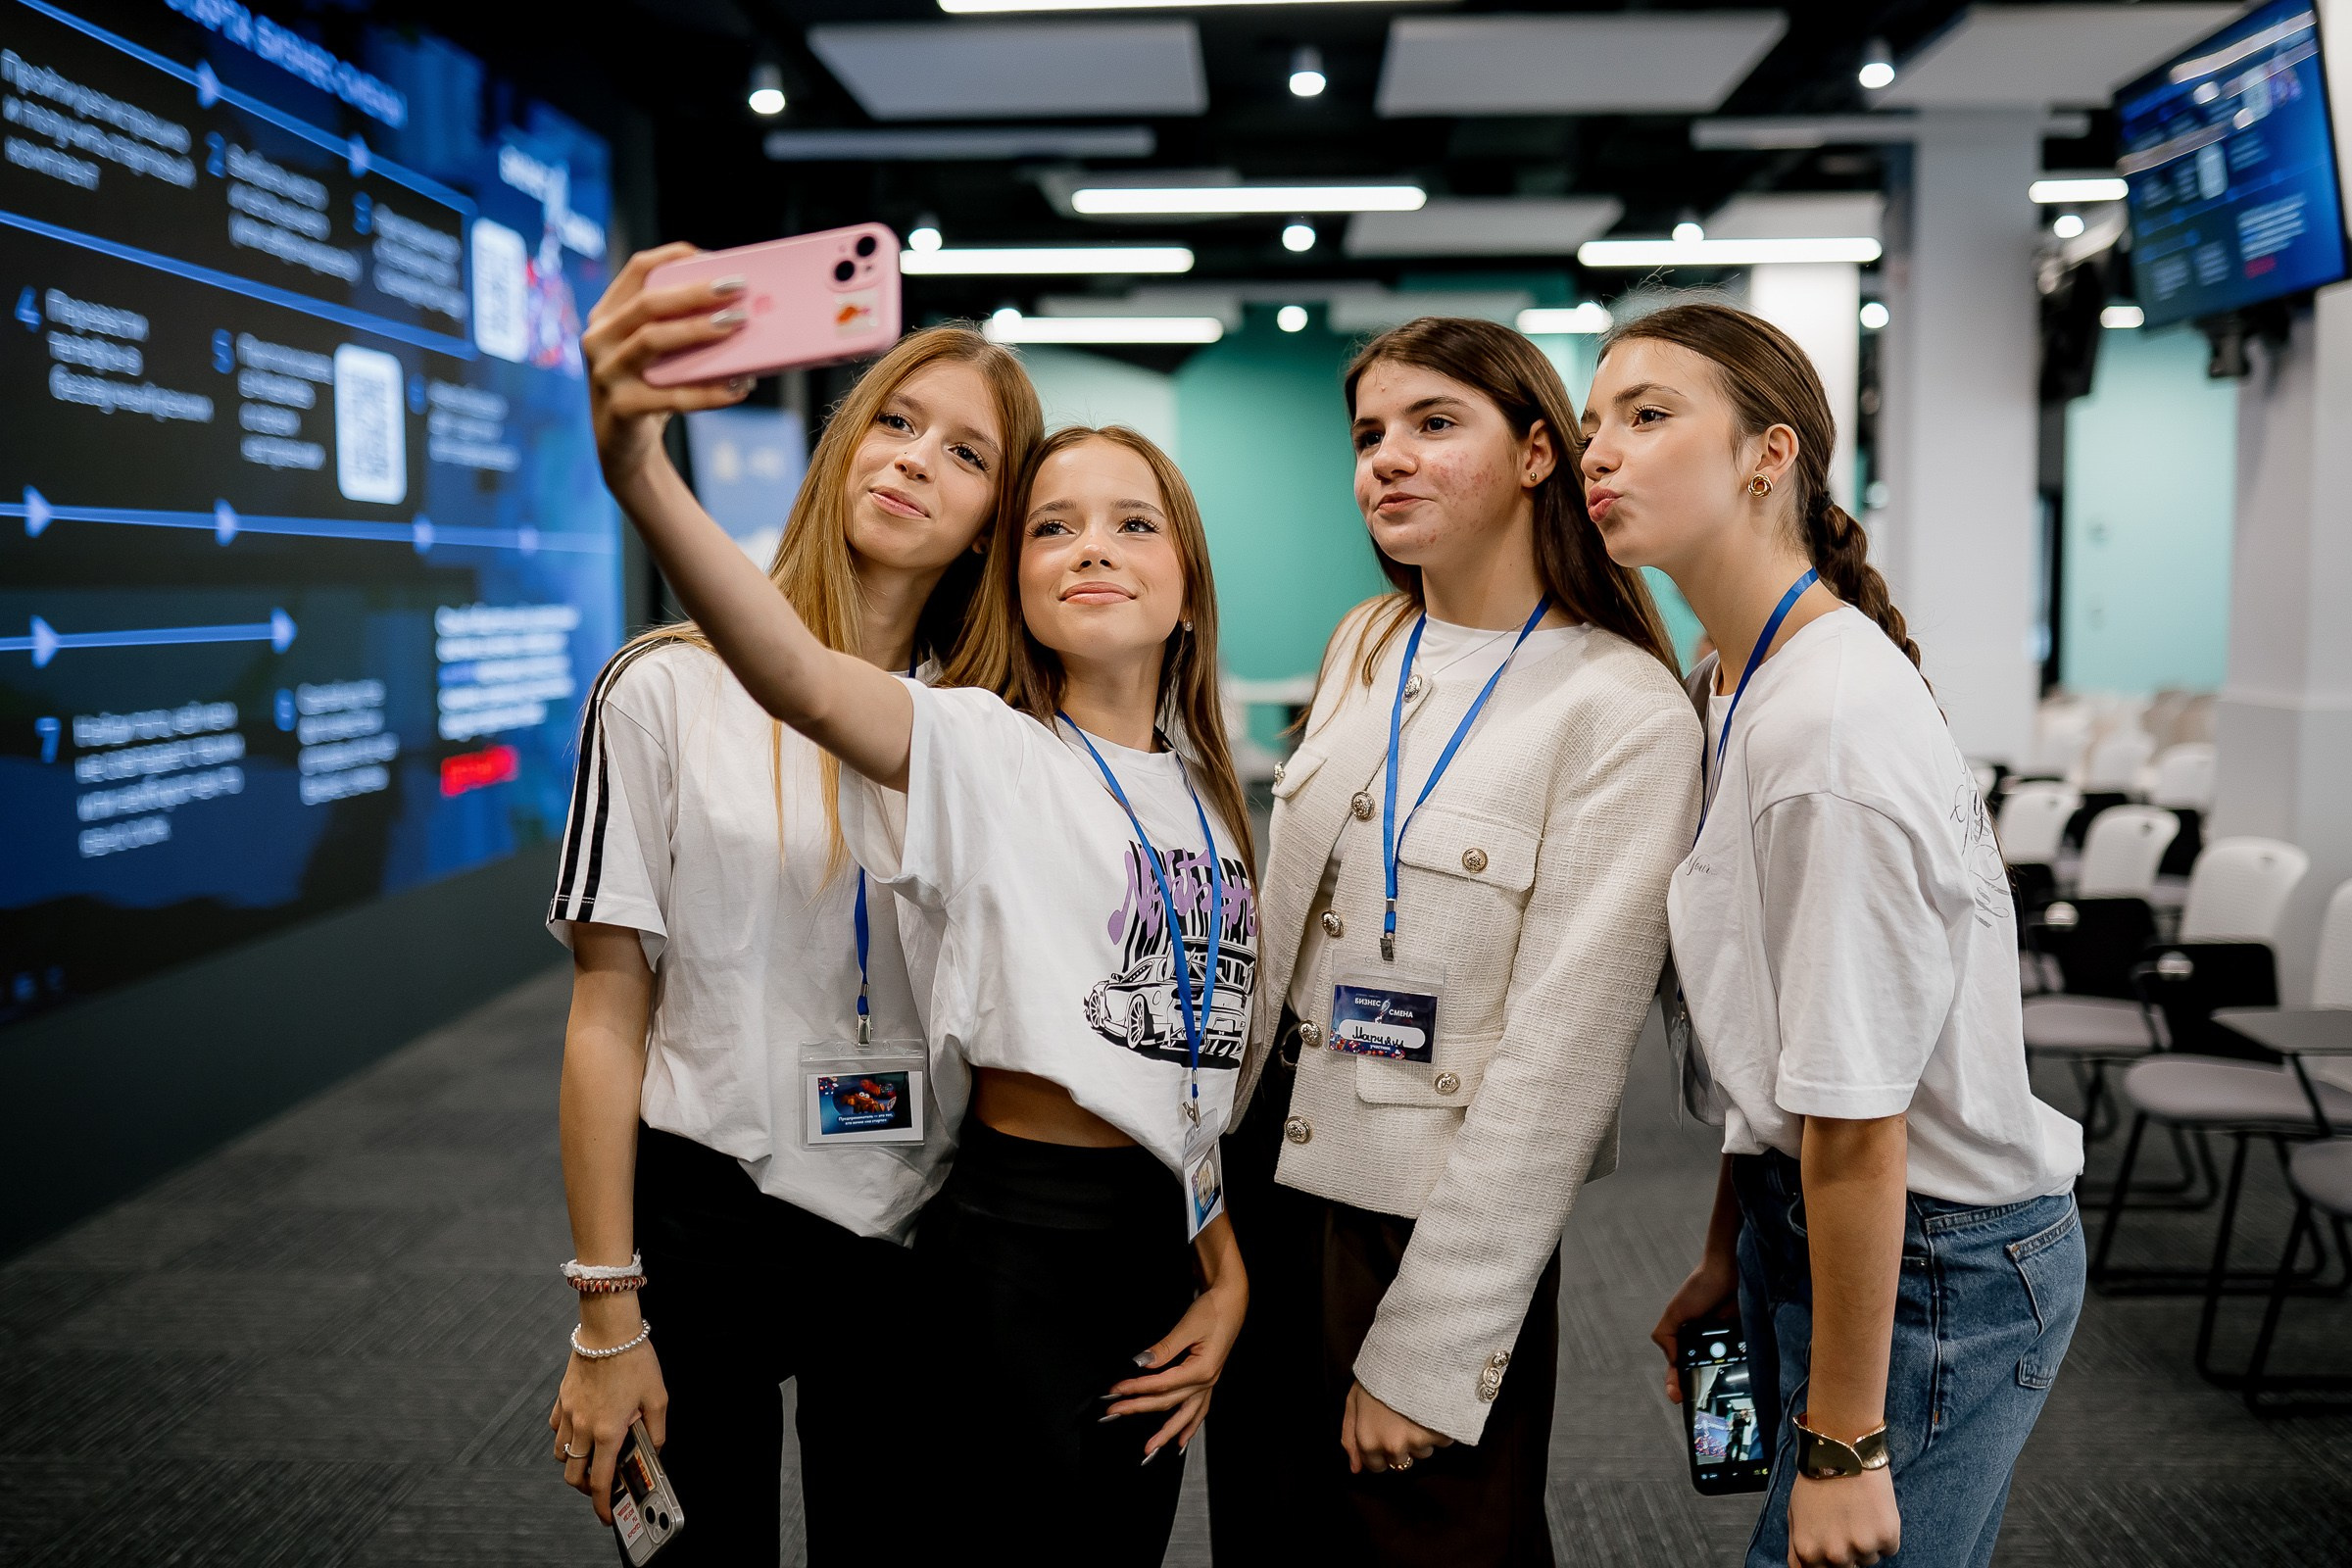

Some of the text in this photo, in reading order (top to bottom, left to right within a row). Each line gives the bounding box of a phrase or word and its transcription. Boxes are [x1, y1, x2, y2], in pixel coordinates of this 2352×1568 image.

[15, 285, 42, 332] 4
[34, 716, 62, 763] 7
[1354, 998, 1381, 1006] БИЗНЕС
[1389, 1009, 1413, 1018] СМЕНА
